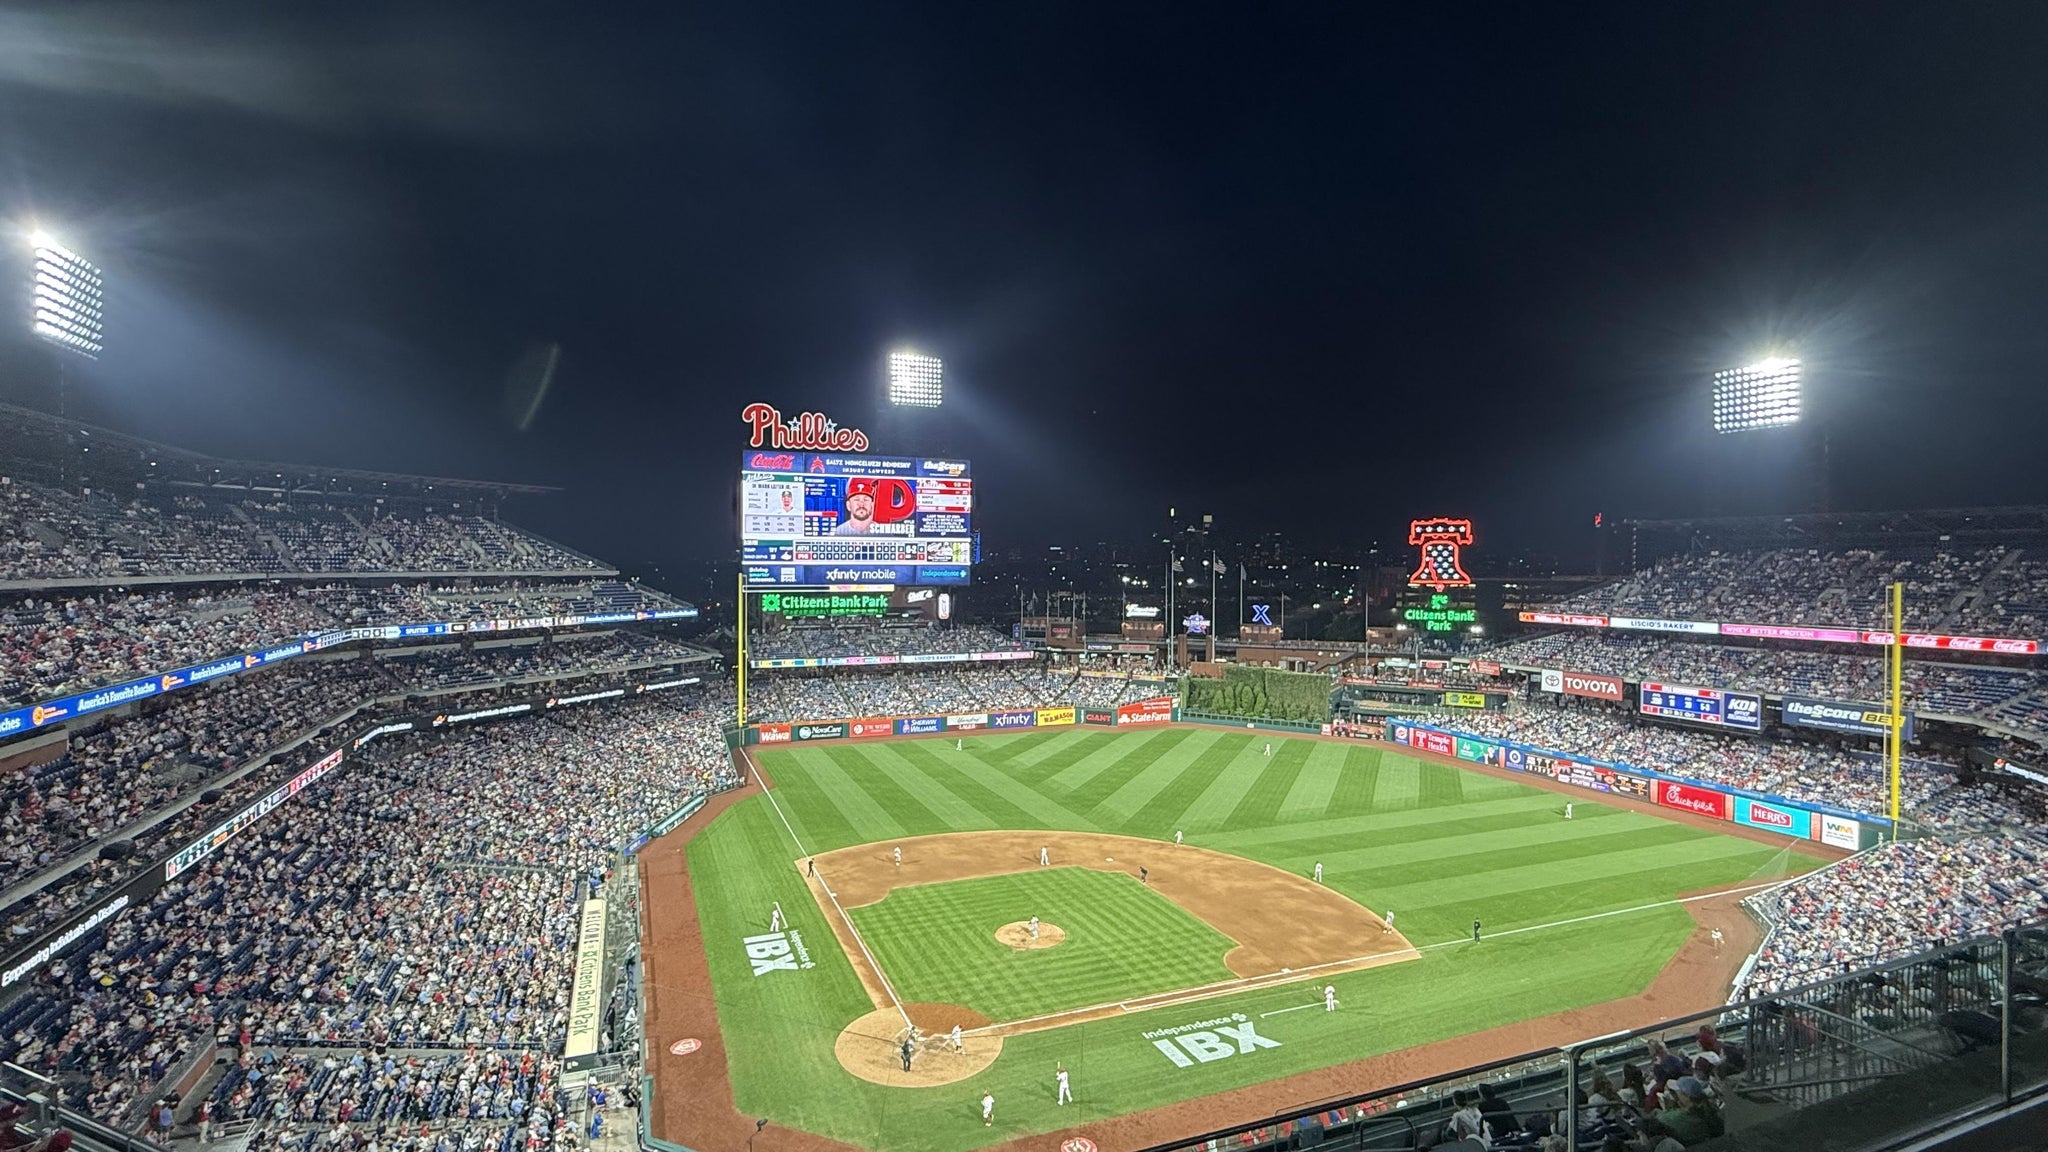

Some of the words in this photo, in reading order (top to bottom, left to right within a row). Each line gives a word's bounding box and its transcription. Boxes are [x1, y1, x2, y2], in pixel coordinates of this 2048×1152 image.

[743, 403, 869, 452] Phillies
[826, 568, 860, 581] xfinity
[861, 569, 896, 579] mobile
[781, 594, 830, 609] Citizens
[831, 595, 860, 608] Bank
[862, 594, 888, 607] Park
[1404, 609, 1446, 620] Citizens
[1447, 609, 1475, 621] Bank
[1427, 620, 1452, 630] Park
[1780, 629, 1814, 637] PROTEIN
[1564, 676, 1618, 695] TOYOTA
[78, 693, 110, 711] America's
[995, 714, 1031, 726] xfinity
[1086, 714, 1111, 722] GIANT
[1787, 702, 1861, 721] theScore
[761, 732, 790, 741] Wawa
[1428, 733, 1451, 745] Temple
[1428, 742, 1449, 753] Health
[1827, 822, 1853, 834] WM
[583, 909, 601, 944] WELCOME
[743, 932, 798, 977] IBX
[2, 947, 49, 987] Empowering
[577, 957, 597, 989] Citizens
[574, 990, 594, 1013] Bank
[571, 1015, 592, 1036] Park
[1142, 1015, 1231, 1040] Independence
[1152, 1021, 1283, 1069] IBX
